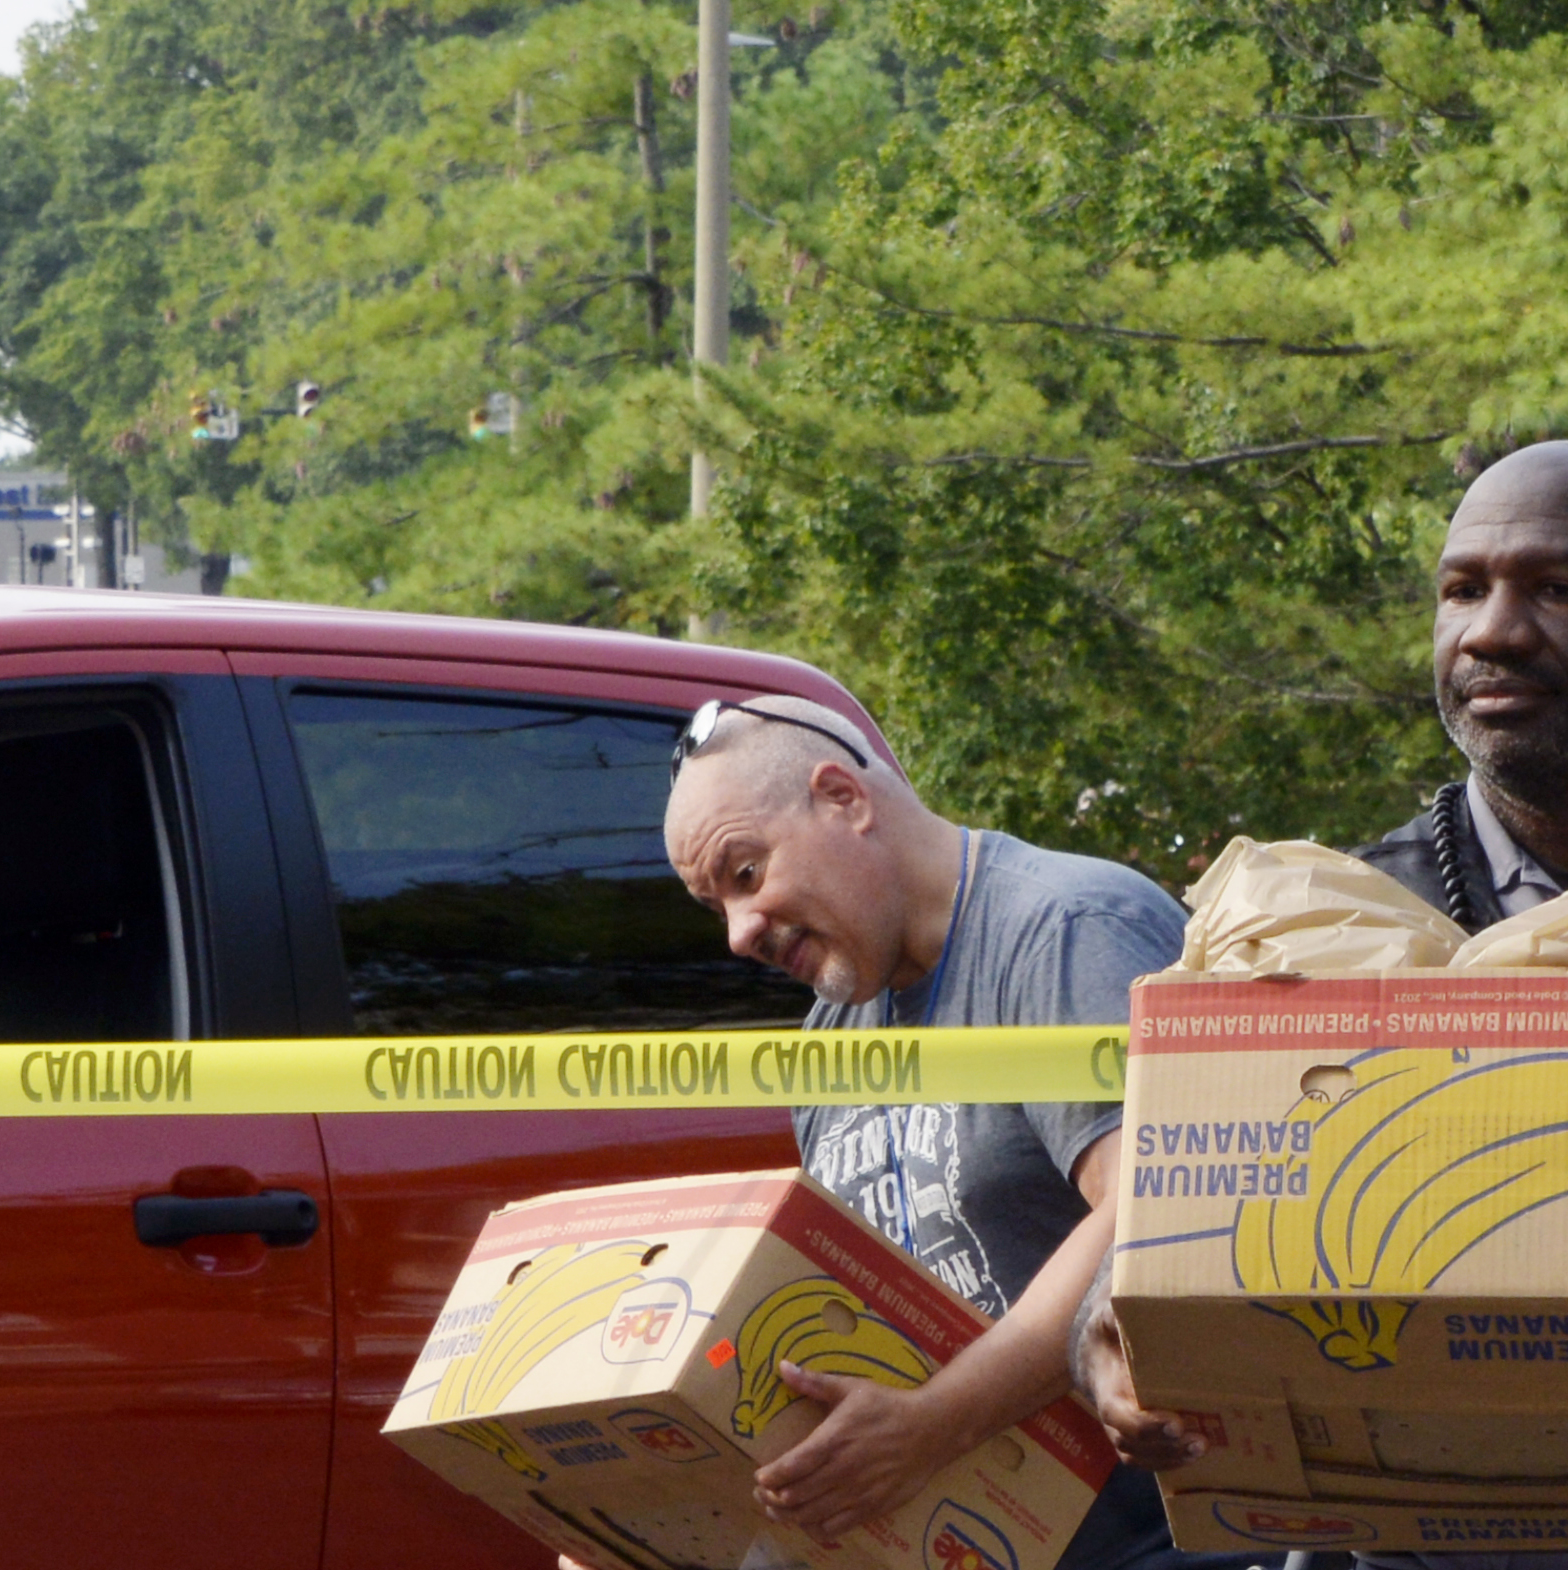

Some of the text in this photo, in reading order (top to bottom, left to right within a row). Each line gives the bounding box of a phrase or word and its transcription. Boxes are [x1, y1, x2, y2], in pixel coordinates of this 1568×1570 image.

[1394, 993, 1421, 1002] 2021
[1505, 991, 1532, 1000] Food
[1534, 991, 1560, 1000] Dole
[1140, 1012, 1370, 1038] PREMIUM BANANAS
[1387, 1012, 1499, 1033] BANANAS
[1136, 1120, 1311, 1157] BANANAS
[1133, 1162, 1309, 1199] PREMIUM
[665, 1205, 713, 1223] BANANAS
[713, 1202, 769, 1217] PREMIUM
[563, 1211, 660, 1236] PREMIUM BANANAS
[810, 1230, 880, 1291] BANANAS
[434, 1300, 502, 1335] BANANAS
[878, 1283, 946, 1345] PREMIUM
[610, 1308, 674, 1348] Dole
[419, 1328, 486, 1364] PREMIUM
[1245, 1511, 1355, 1533] Dole
